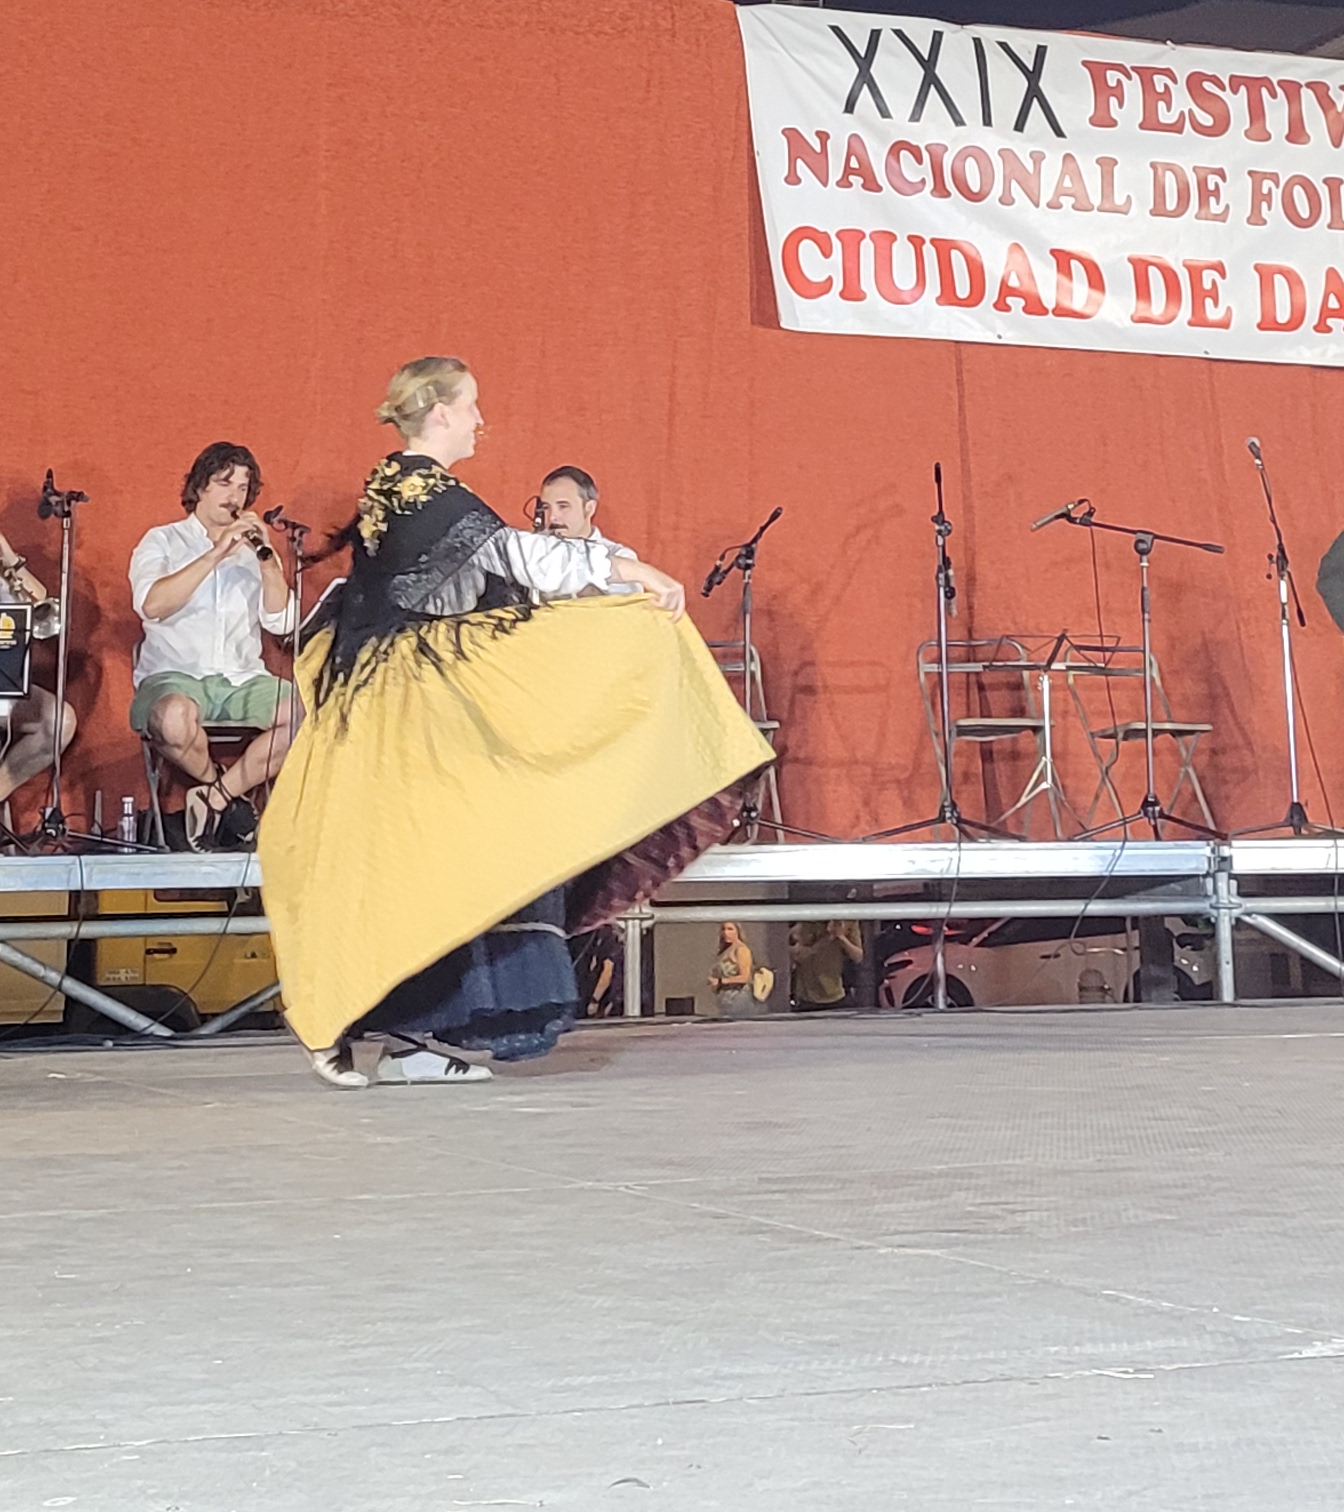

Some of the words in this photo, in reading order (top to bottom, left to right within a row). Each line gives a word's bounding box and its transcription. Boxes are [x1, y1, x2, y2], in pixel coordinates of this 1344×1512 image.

[827, 23, 1068, 140] XXIX
[781, 126, 1133, 217] NACIONAL
[1150, 162, 1232, 224] DE
[780, 224, 1108, 322] CIUDAD
[1126, 255, 1234, 332] DE
